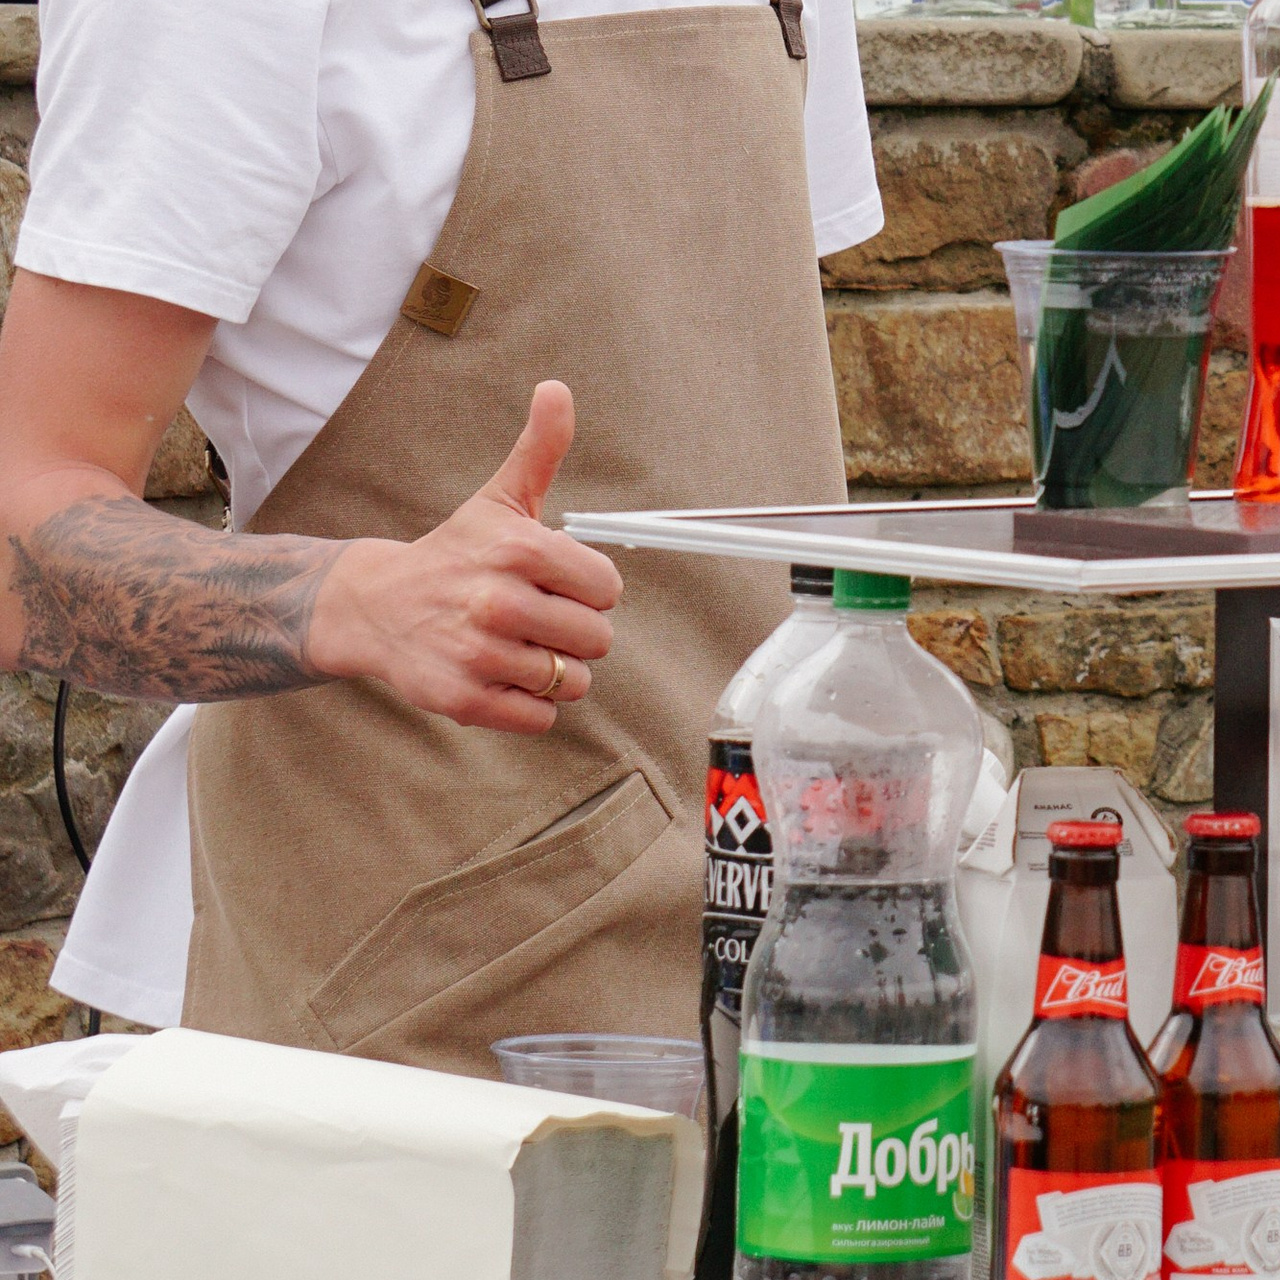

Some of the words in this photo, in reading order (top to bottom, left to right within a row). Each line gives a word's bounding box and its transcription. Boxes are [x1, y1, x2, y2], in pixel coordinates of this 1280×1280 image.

[1034, 803, 1073, 811] АНАНАС
[1061, 970, 1124, 999] Bud
[832, 1222, 854, 1234] вкус
